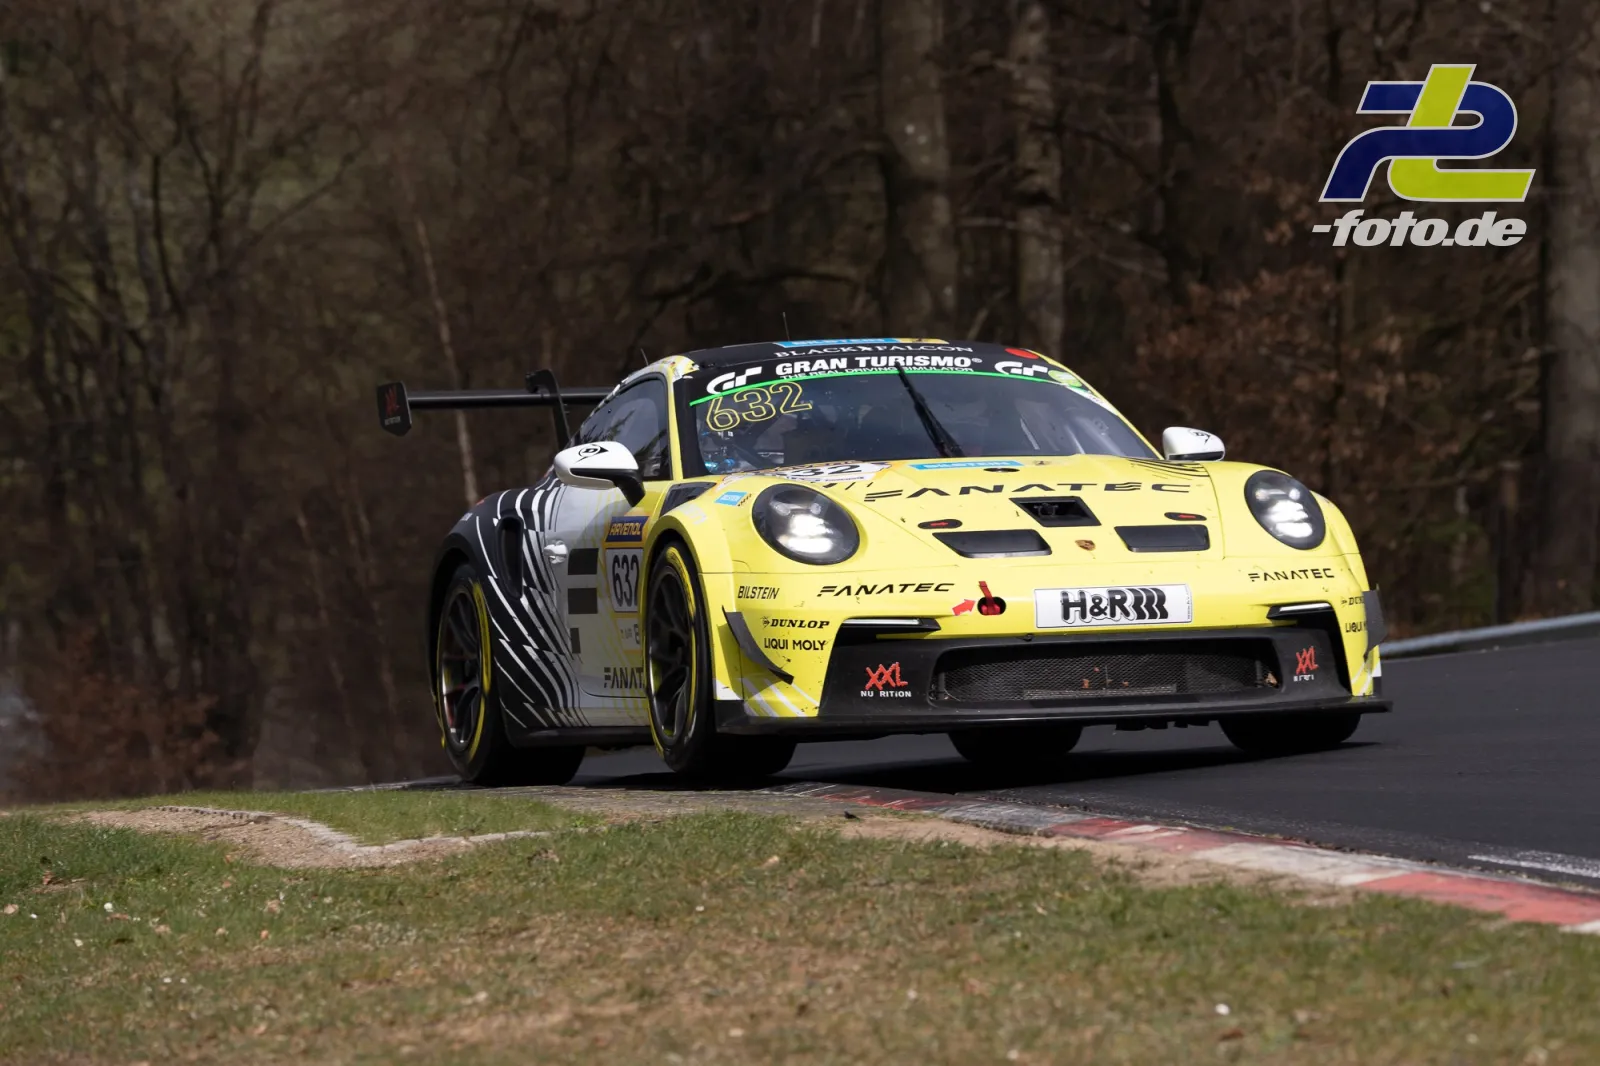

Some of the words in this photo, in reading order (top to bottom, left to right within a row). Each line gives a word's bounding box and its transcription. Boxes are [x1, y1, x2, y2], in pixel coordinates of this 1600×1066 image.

[776, 346, 852, 357] BLACK
[775, 358, 847, 376] GRAN
[706, 381, 813, 431] 632
[776, 464, 862, 477] 32
[863, 482, 1190, 502] FANATEC
[608, 522, 643, 536] RAVENOL
[1248, 568, 1335, 582] FANATEC
[737, 585, 780, 600] BILSTEIN
[816, 582, 955, 598] FANATEC
[770, 618, 830, 629] DUNLOP
[763, 637, 789, 650] LIQUI
[792, 640, 827, 651] MOLY
[603, 667, 645, 689] FANAT
[864, 661, 909, 690] XXL
